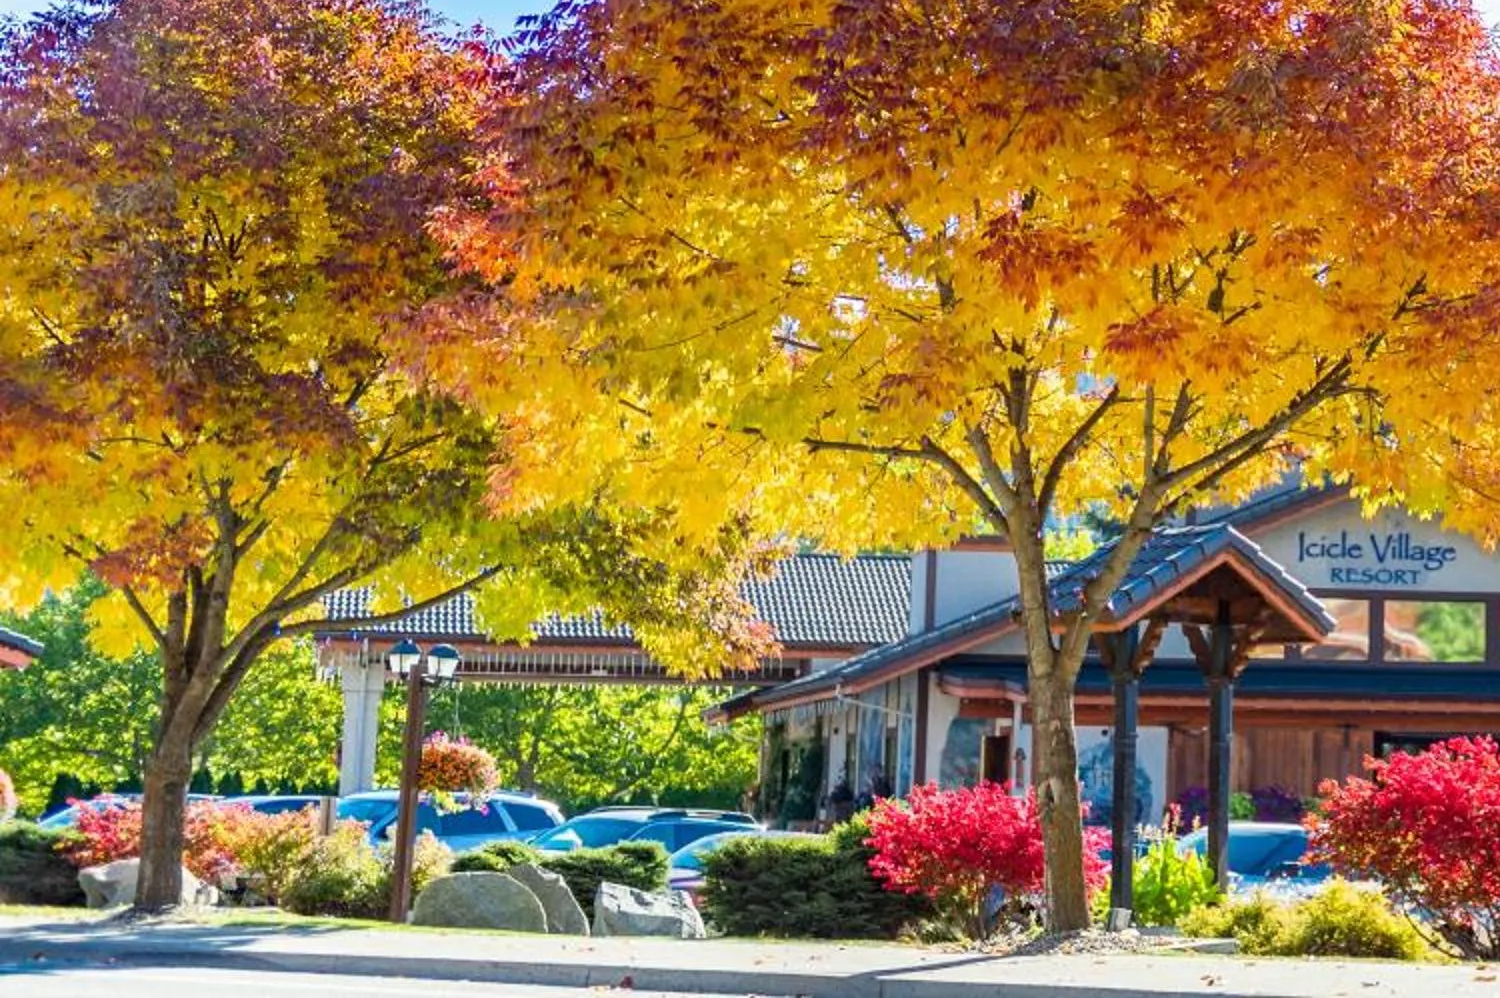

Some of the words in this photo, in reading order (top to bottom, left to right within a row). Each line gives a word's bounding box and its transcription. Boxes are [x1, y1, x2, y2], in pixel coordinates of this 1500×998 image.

[1298, 530, 1363, 562] Icicle
[1370, 532, 1457, 571] Village
[1330, 567, 1421, 584] RESORT
